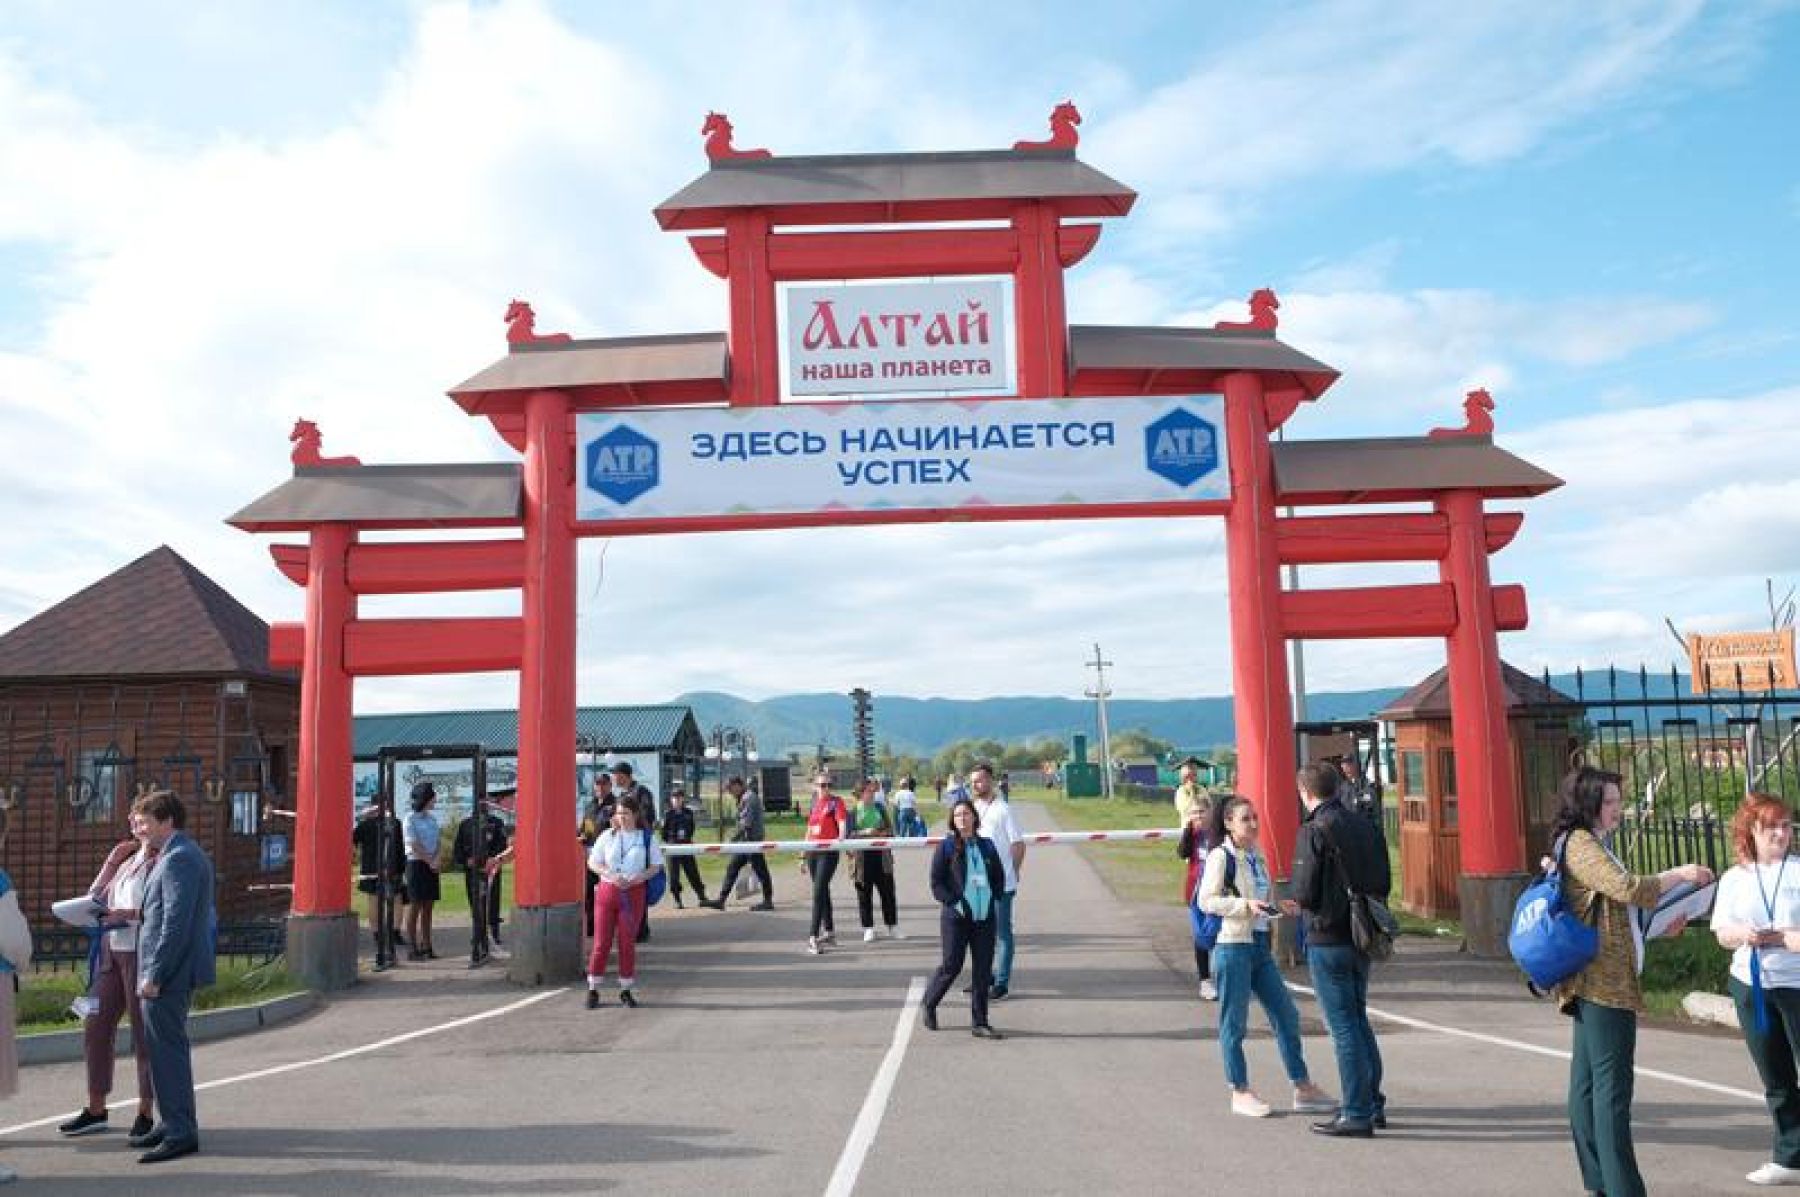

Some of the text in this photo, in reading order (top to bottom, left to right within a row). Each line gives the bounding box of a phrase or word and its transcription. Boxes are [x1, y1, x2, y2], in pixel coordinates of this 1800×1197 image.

[803, 299, 989, 350] Алтай
[802, 359, 991, 380] наша планета
[692, 422, 1116, 461] ЗДЕСЬ НАЧИНАЕТСЯ
[836, 458, 971, 486] УСПЕХ
